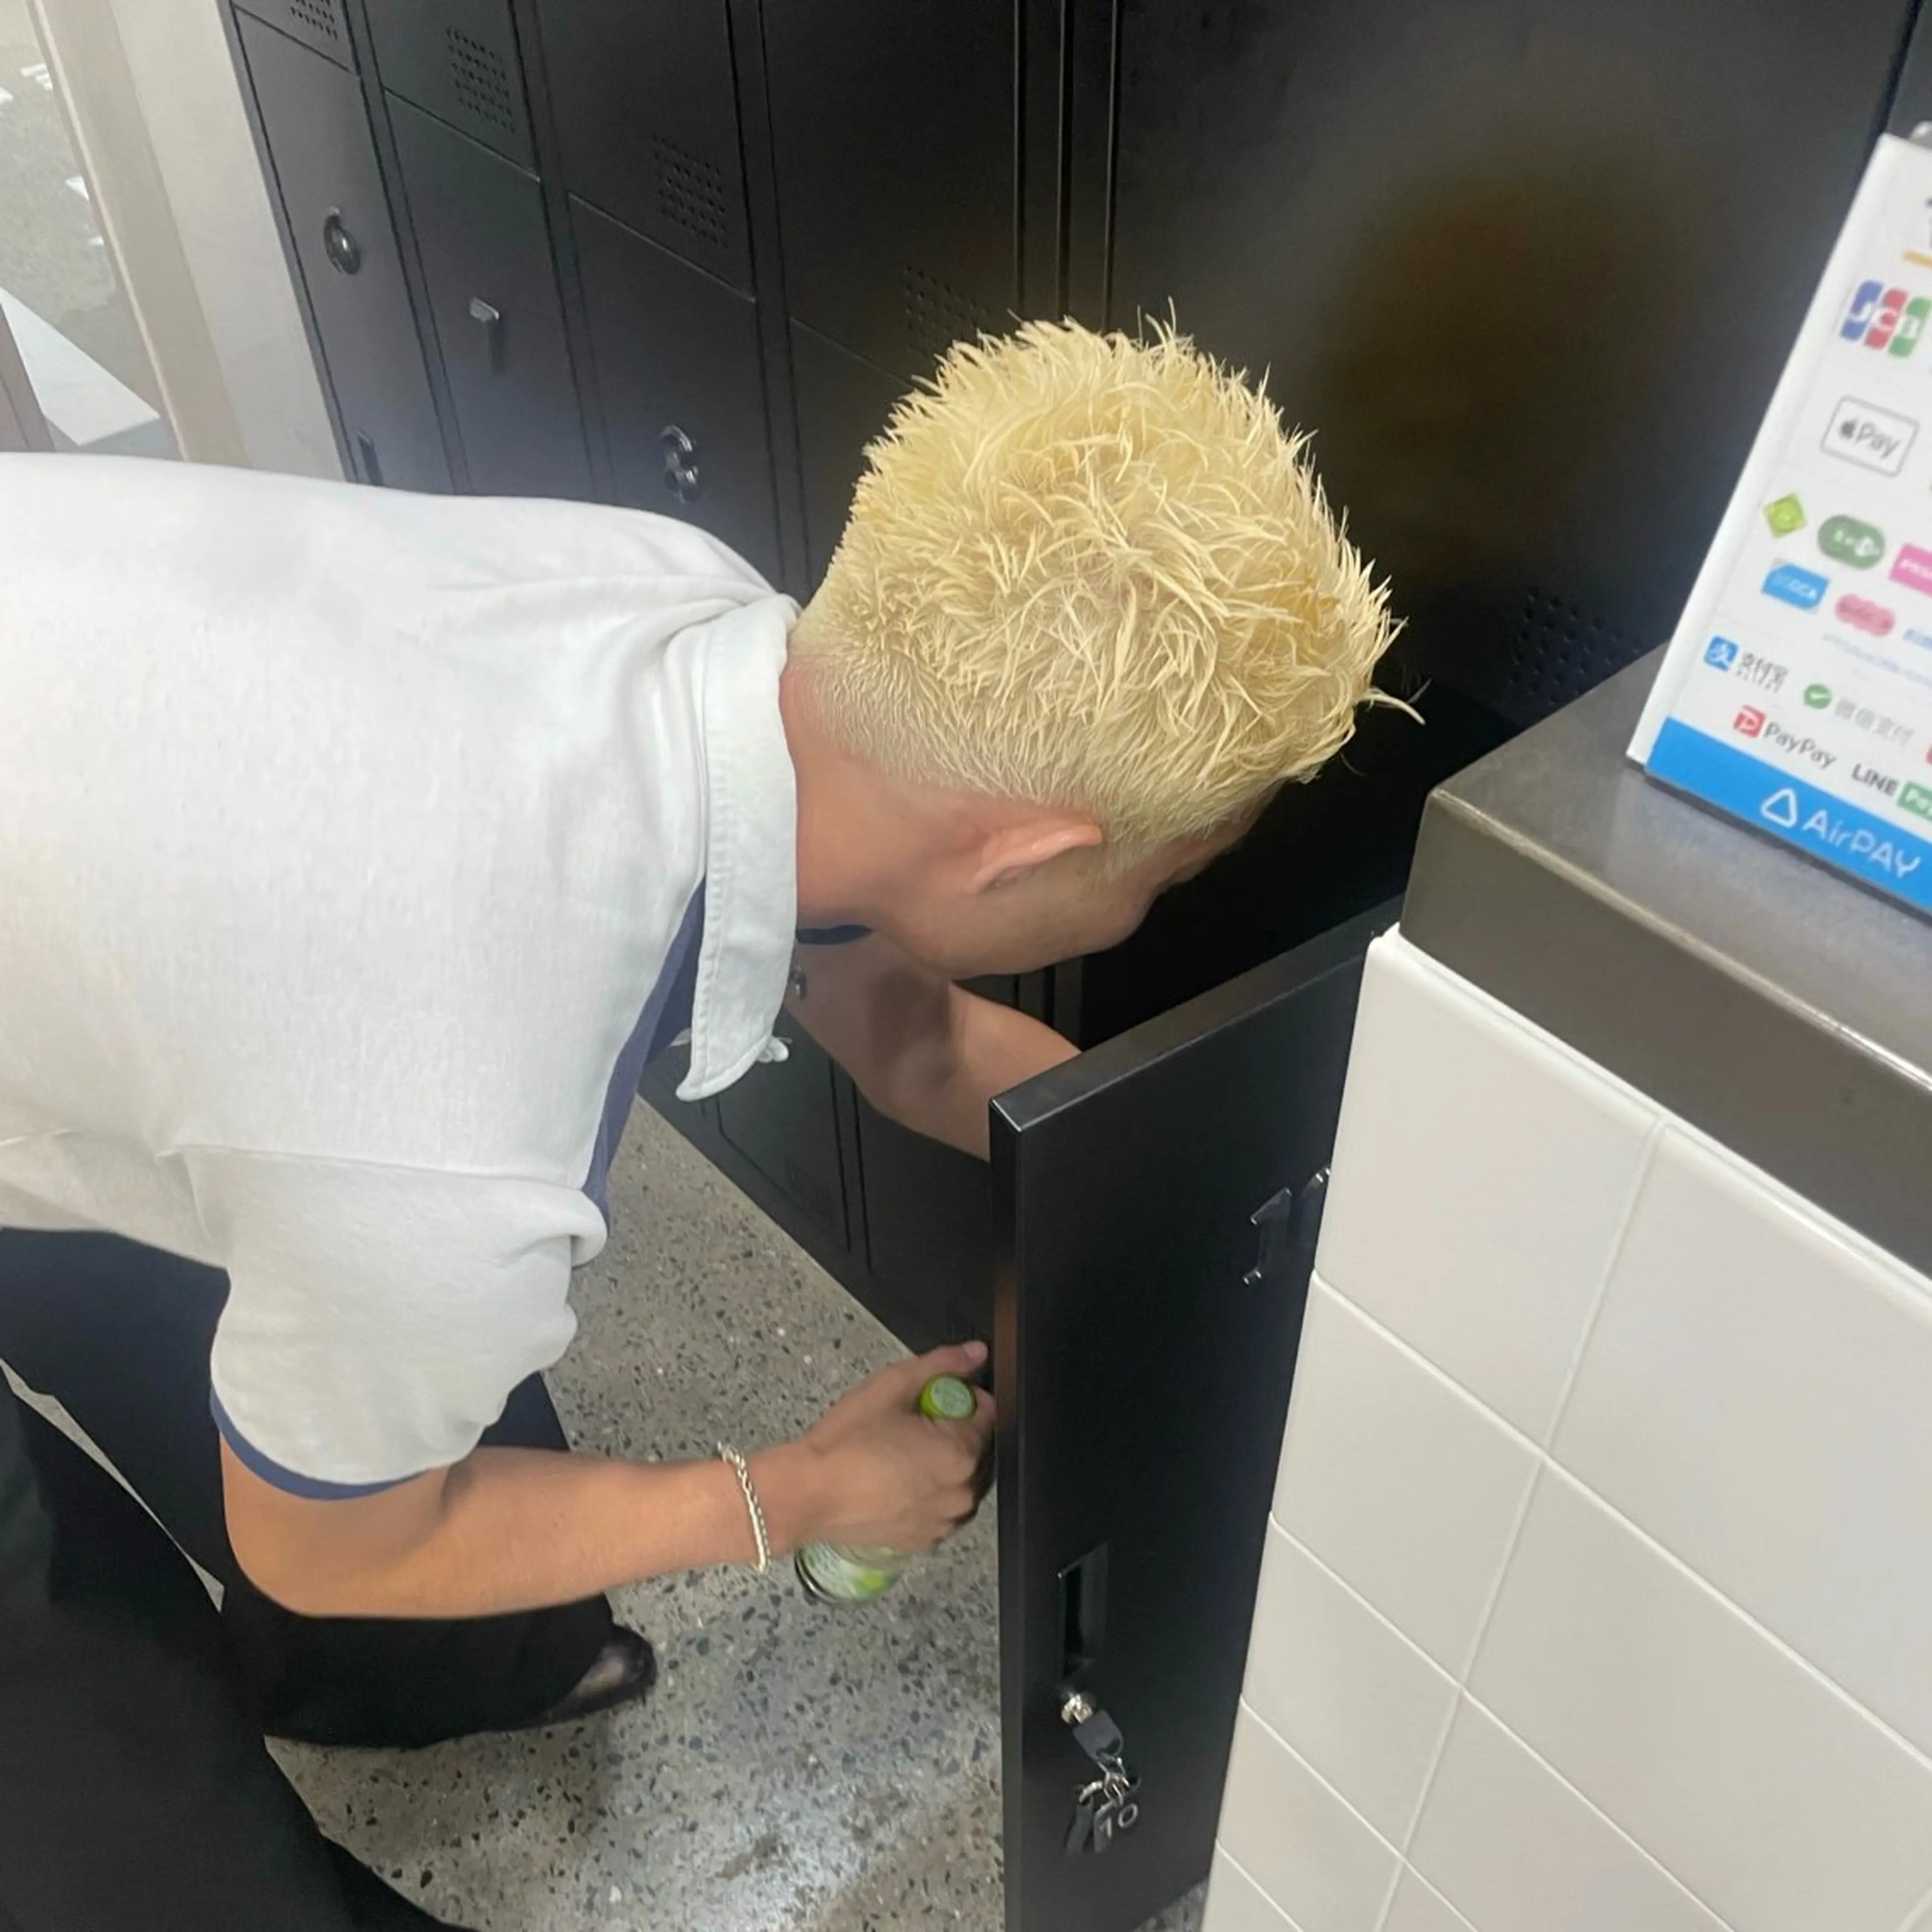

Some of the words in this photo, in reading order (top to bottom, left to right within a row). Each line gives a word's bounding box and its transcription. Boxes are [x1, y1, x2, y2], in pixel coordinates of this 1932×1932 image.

[1855, 421, 1901, 459] Pay
[1763, 720, 1837, 770] PayPay
[1852, 763, 1899, 796] LINE
[1801, 809, 1922, 880] AirPAY
